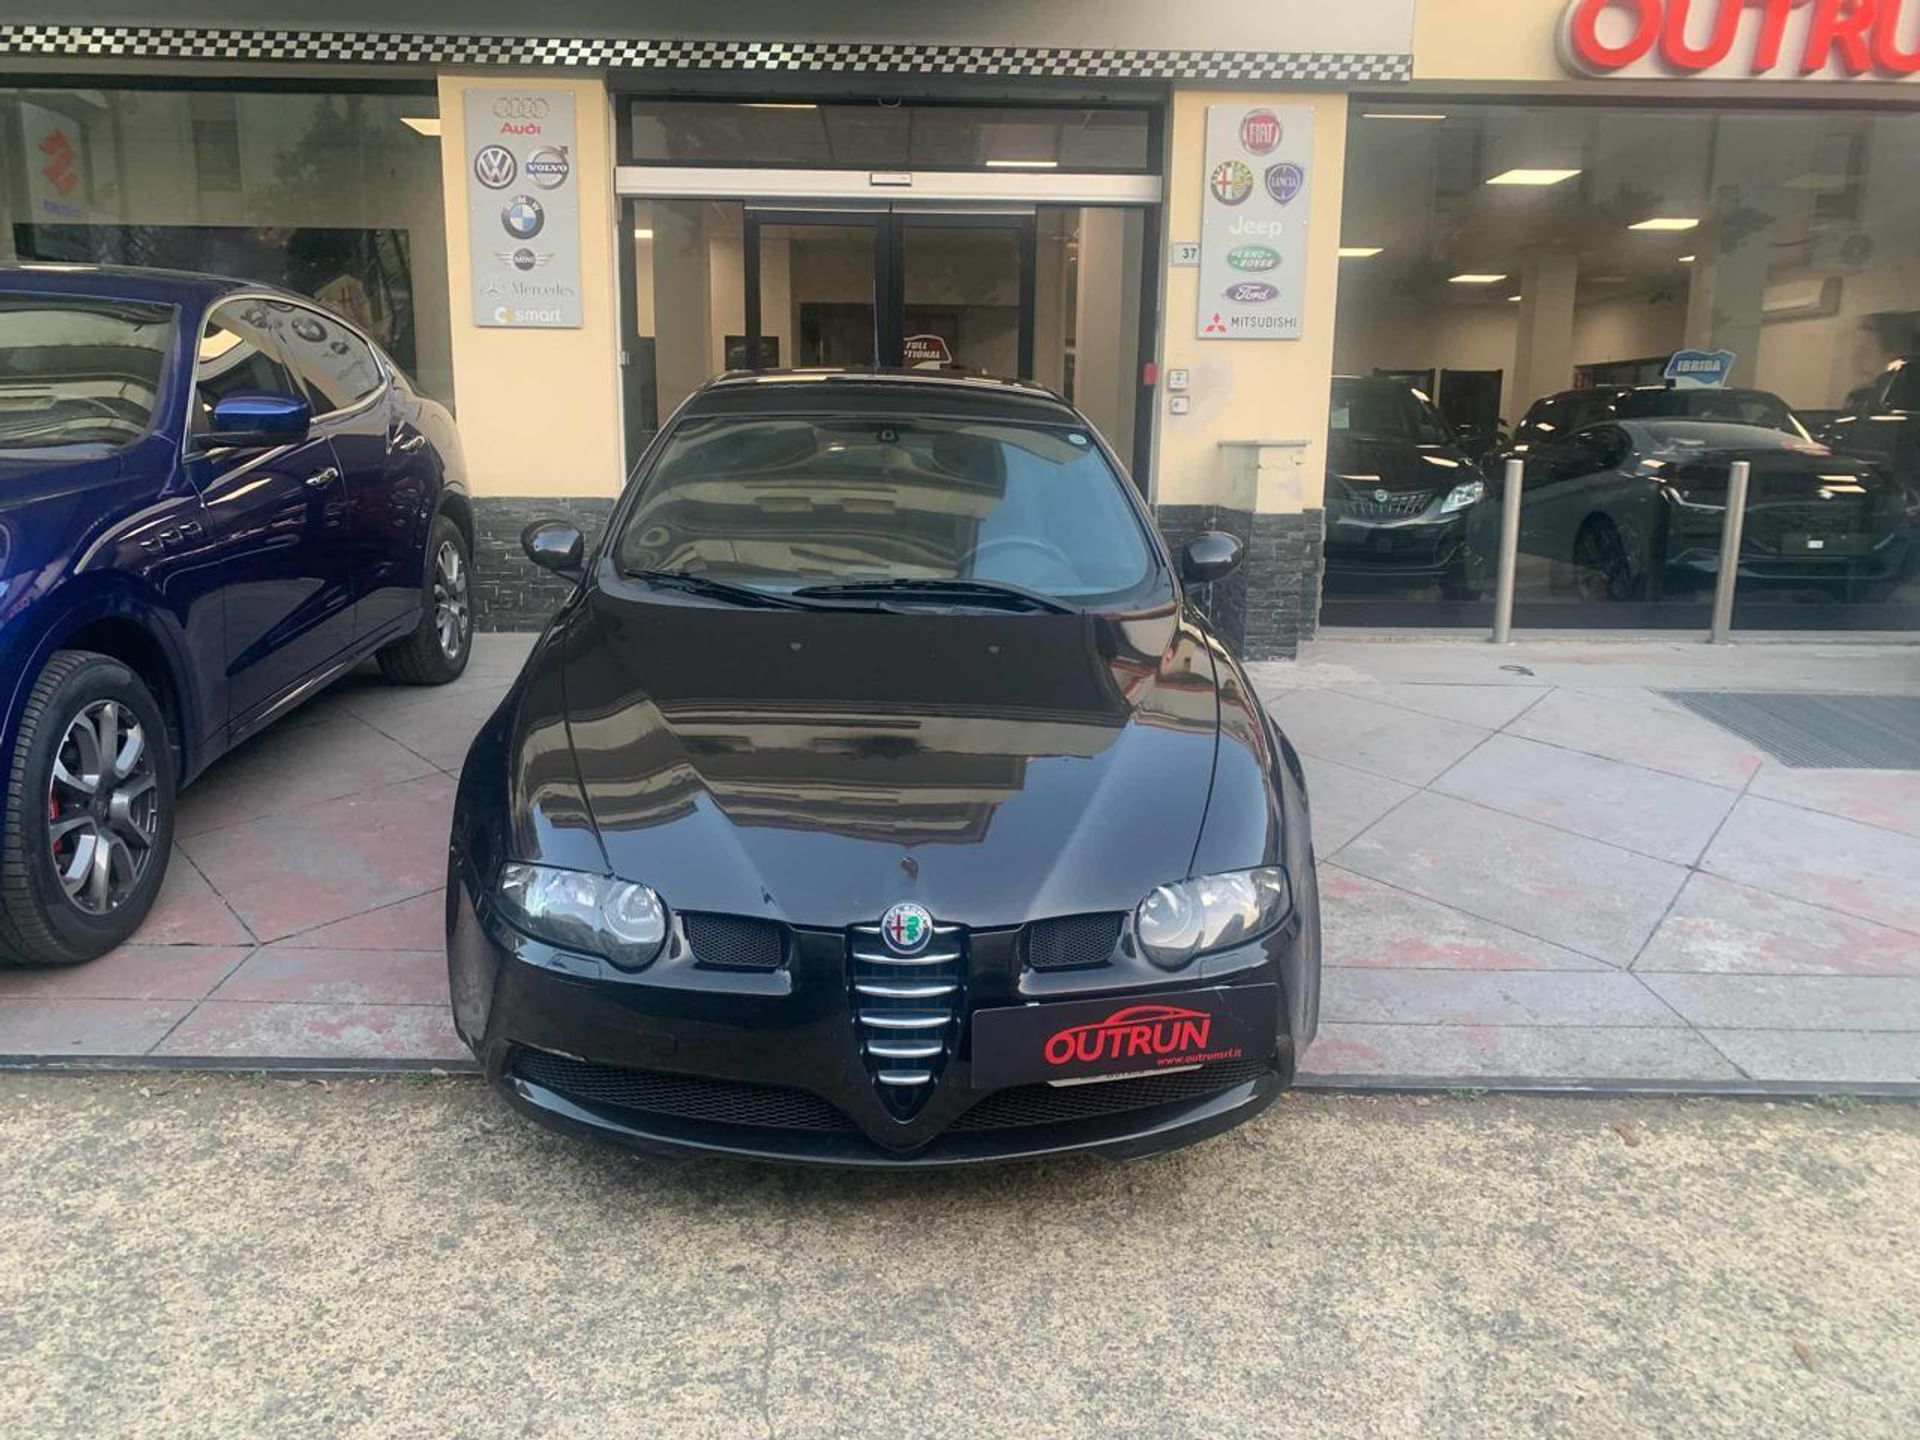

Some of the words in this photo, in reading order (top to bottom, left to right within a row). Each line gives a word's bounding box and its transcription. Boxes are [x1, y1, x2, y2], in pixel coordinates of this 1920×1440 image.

[501, 122, 541, 135] Audi
[1250, 123, 1274, 144] FIAT
[527, 163, 568, 173] VOLVO
[1229, 215, 1283, 238] Jeep
[1182, 247, 1198, 259] 37
[512, 281, 575, 297] Mercedes
[1235, 285, 1271, 300] Ford
[515, 308, 561, 322] smart
[1230, 316, 1297, 329] MITSUBISHI
[906, 341, 928, 350] FULL
[1044, 1017, 1211, 1064] OUTRUN
